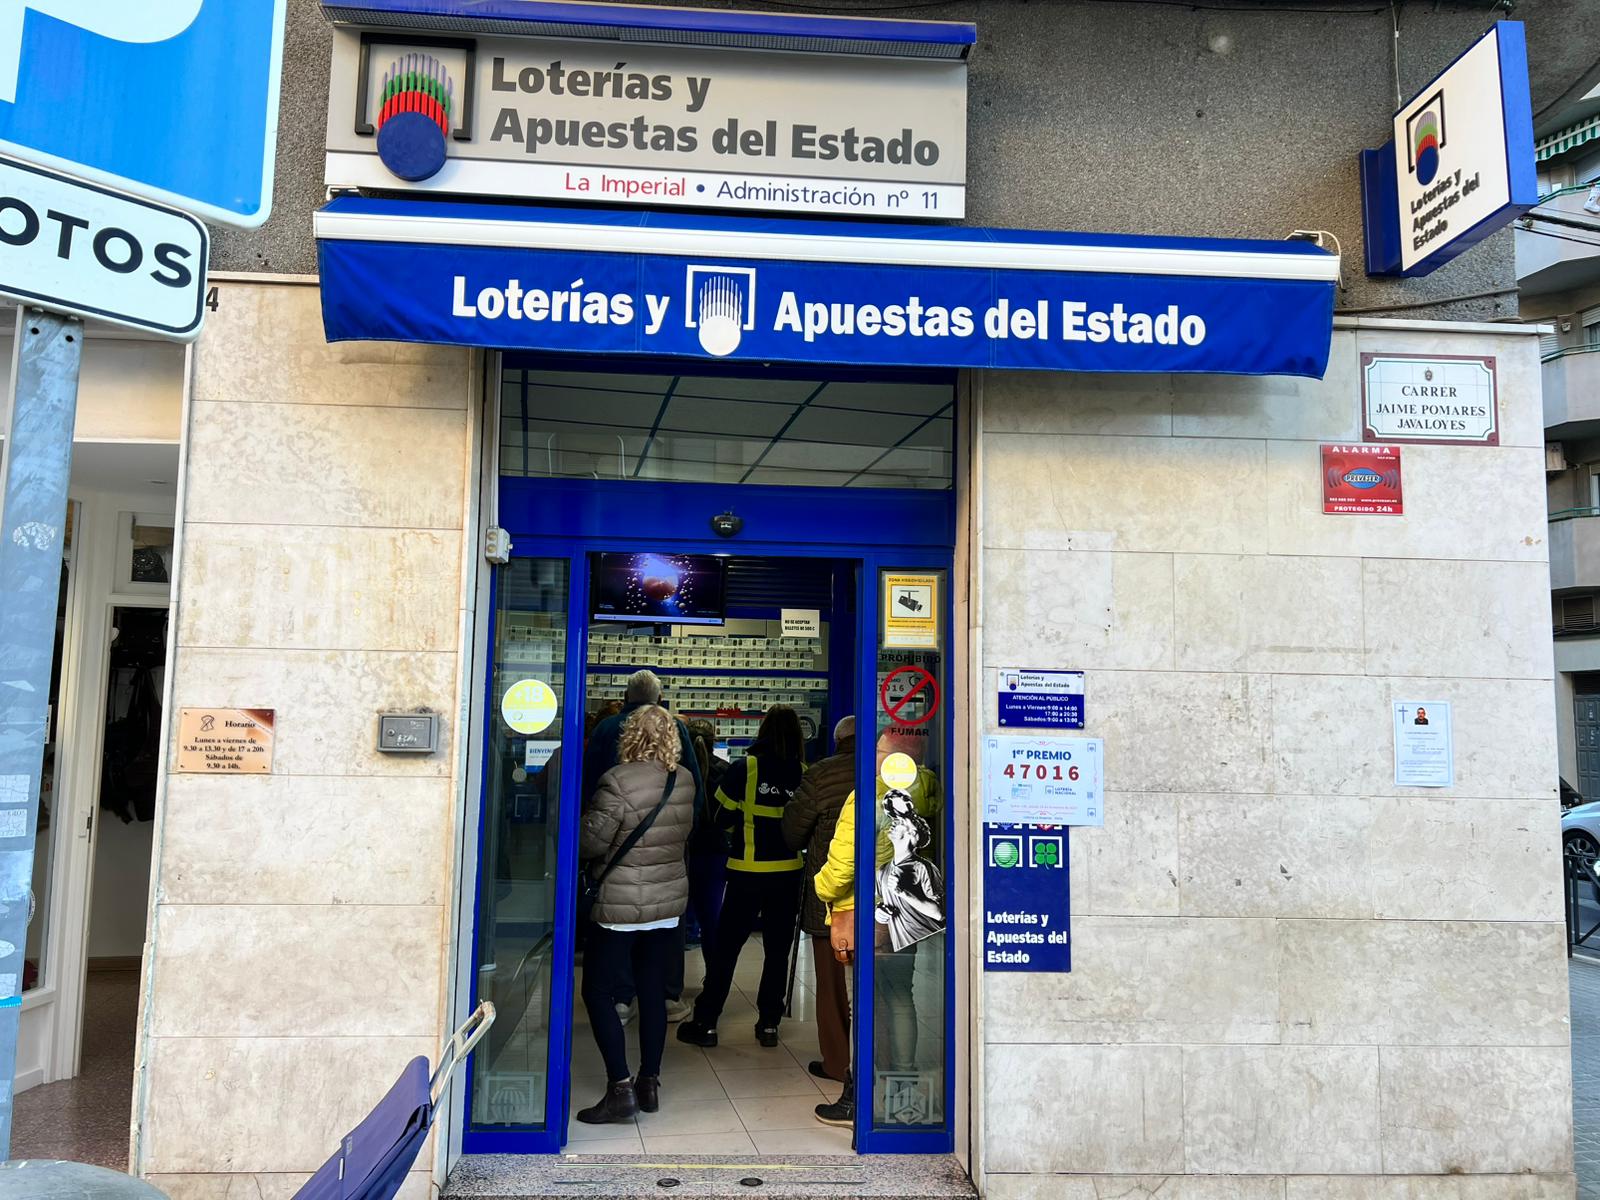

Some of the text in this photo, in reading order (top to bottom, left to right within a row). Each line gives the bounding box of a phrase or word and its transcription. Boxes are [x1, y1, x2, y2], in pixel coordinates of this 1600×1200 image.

[490, 56, 712, 112] Loterías y
[489, 107, 940, 167] Apuestas del Estado
[565, 172, 590, 192] La
[601, 174, 686, 198] Imperial
[717, 181, 876, 207] Administración
[921, 191, 939, 210] 11
[1410, 168, 1461, 214] Loterías y
[1413, 171, 1480, 232] Apuestas del
[1413, 219, 1448, 251] Estado
[452, 276, 1206, 346] Loterías y Apuestas del Estado
[1401, 385, 1458, 398] CARRER
[1376, 403, 1486, 417] JAIME POMARES
[1397, 418, 1466, 431] JAVALOYES
[1332, 446, 1391, 454] ALARMA
[224, 720, 256, 728] Horario
[891, 727, 930, 737] FUMAR
[1026, 750, 1072, 761] PREMIO
[1003, 763, 1080, 781] 47016
[986, 911, 1049, 927] Loterías y
[986, 930, 1067, 946] Apuestas del
[987, 950, 1030, 963] Estado
